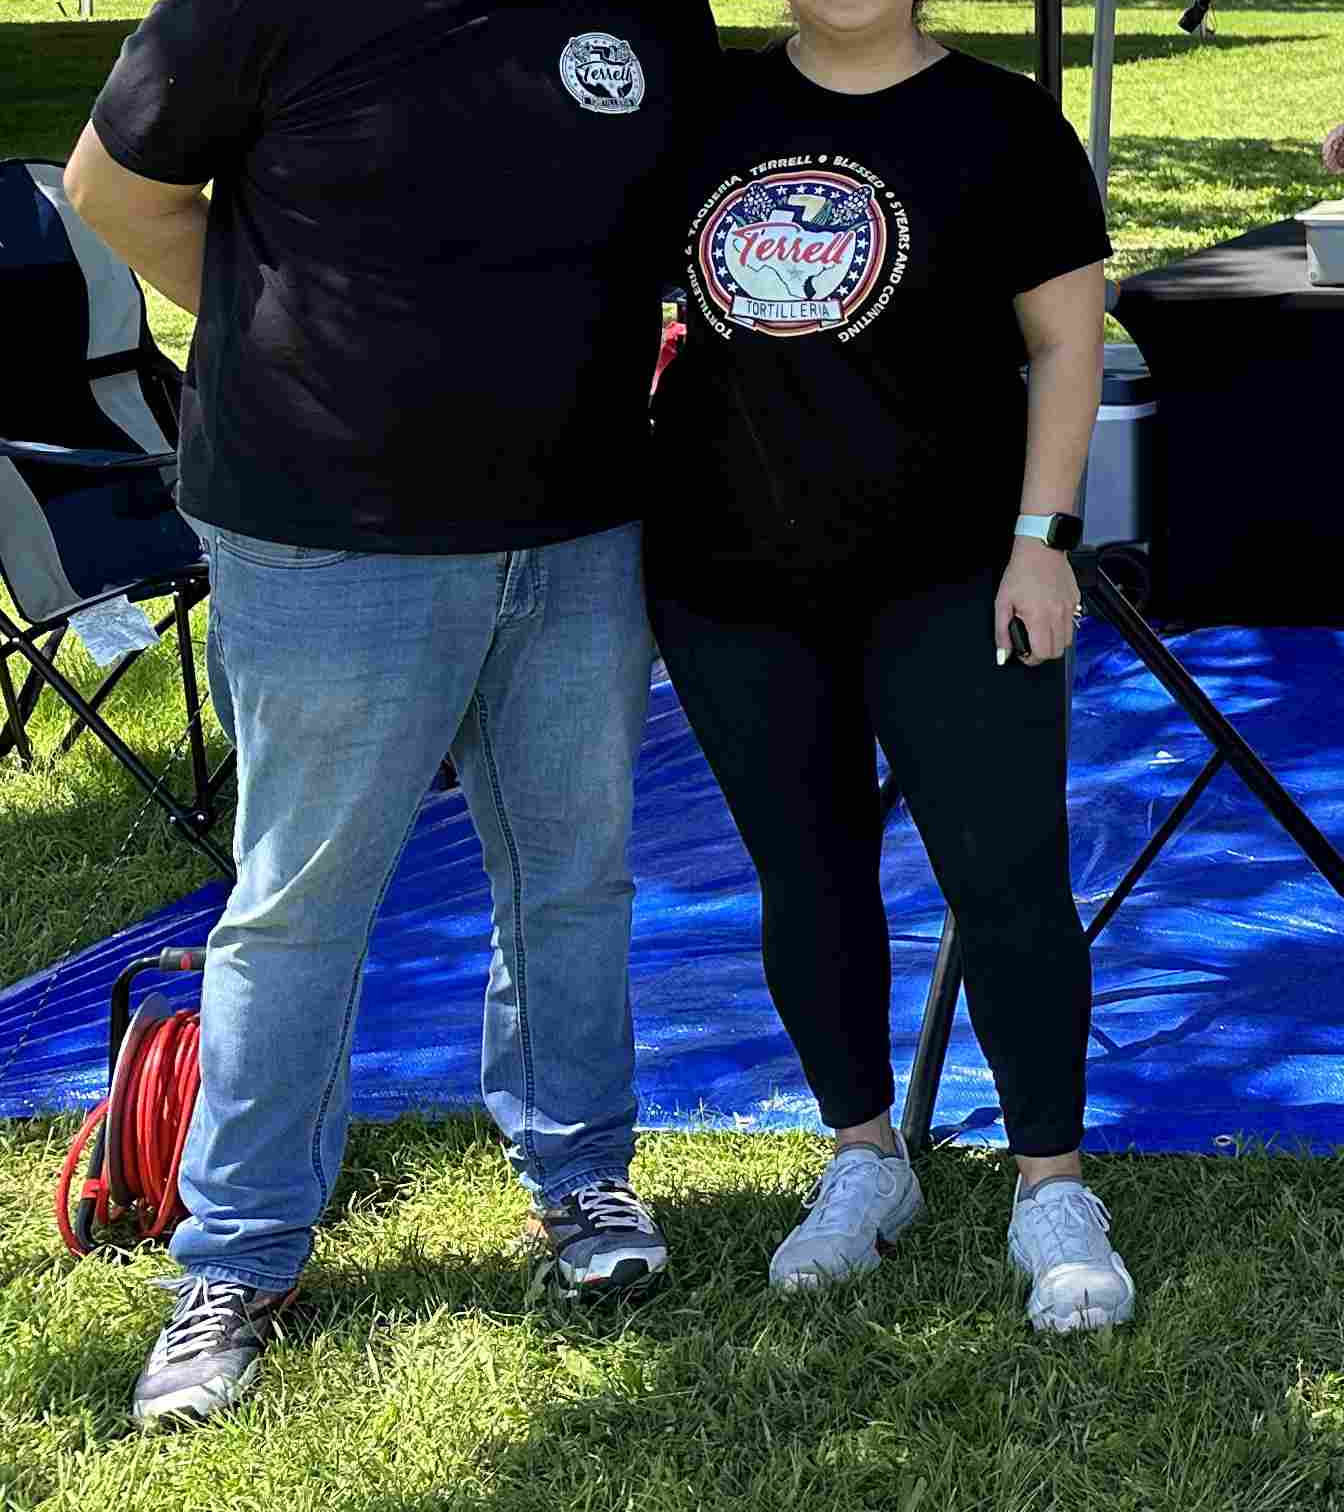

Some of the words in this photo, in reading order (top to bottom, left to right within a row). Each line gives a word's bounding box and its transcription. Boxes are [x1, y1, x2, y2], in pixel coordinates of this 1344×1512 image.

[749, 154, 813, 177] TERRELL
[832, 155, 886, 189] BLESSED
[688, 174, 742, 238] TAQUERIA
[732, 230, 856, 266] Terrell
[745, 300, 830, 318] TORTILLERIA
[836, 284, 895, 343] COUNTING
